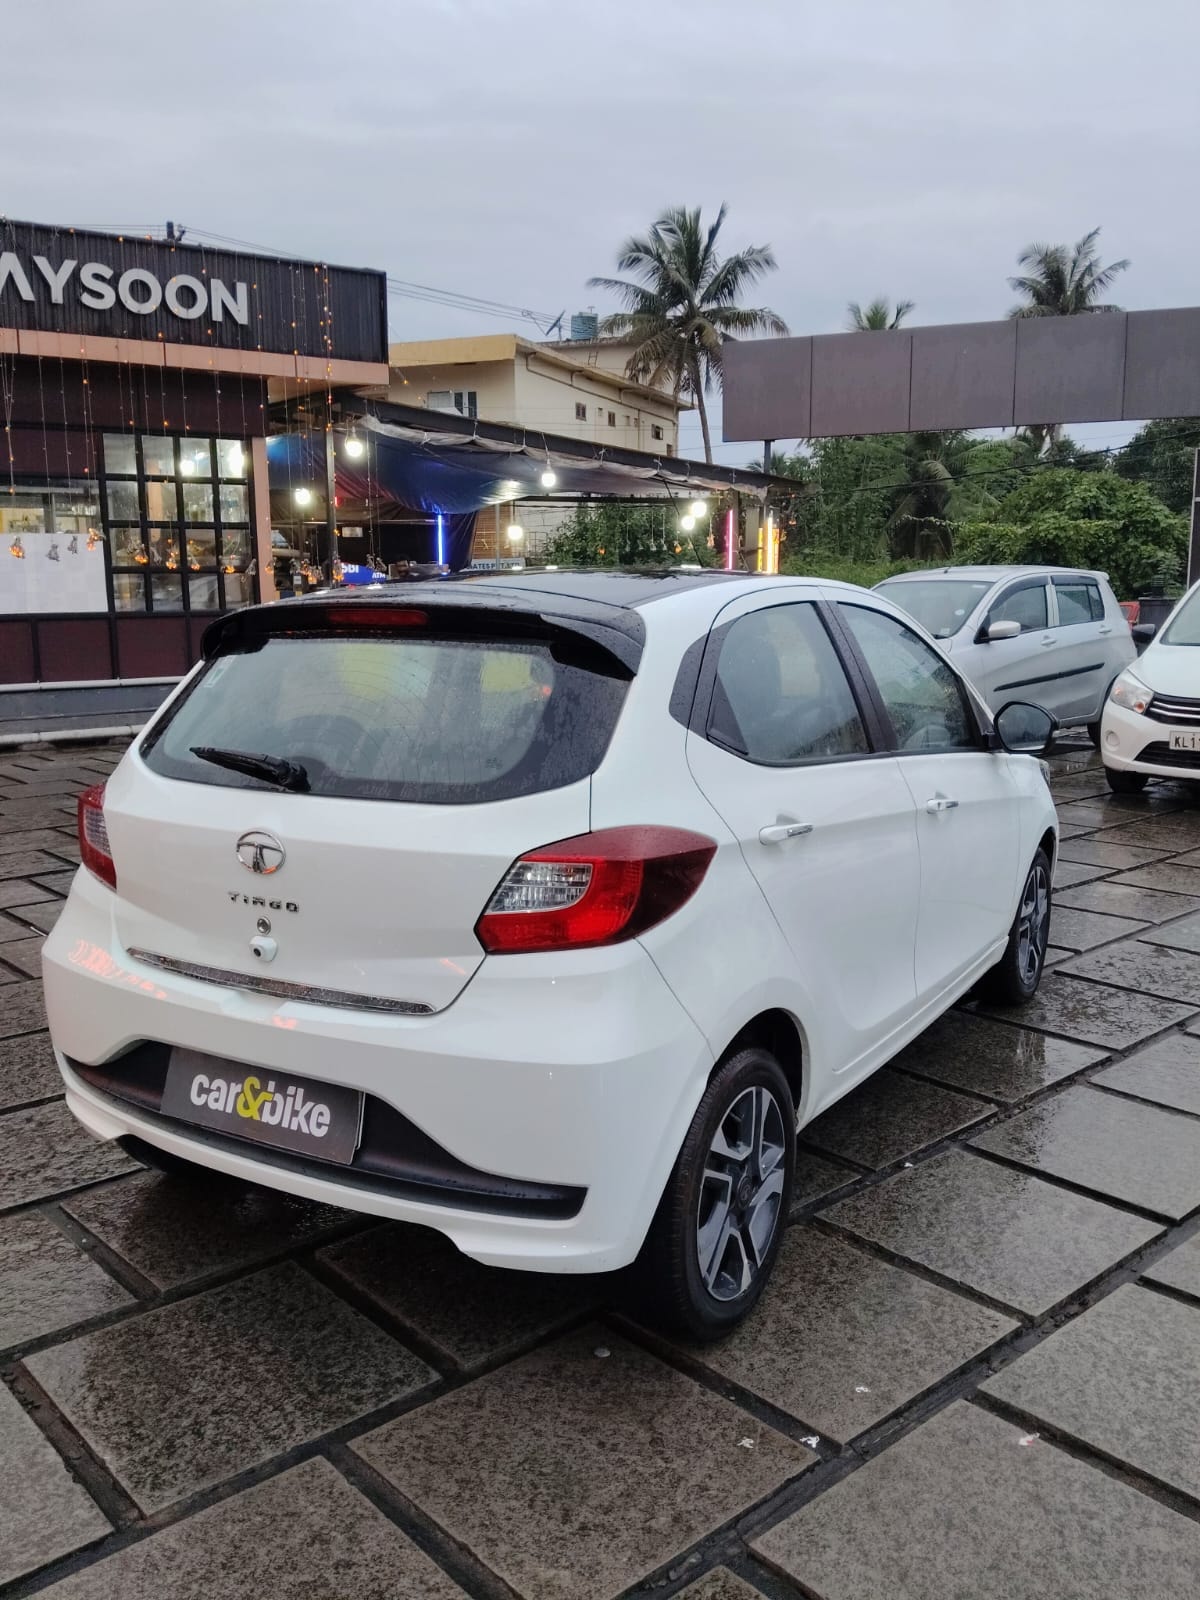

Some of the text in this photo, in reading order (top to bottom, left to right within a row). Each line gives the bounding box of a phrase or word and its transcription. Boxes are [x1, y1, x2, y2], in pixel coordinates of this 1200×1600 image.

[0, 251, 249, 325] AYSOON
[1174, 736, 1200, 749] KL1
[190, 1074, 331, 1137] car&bike
